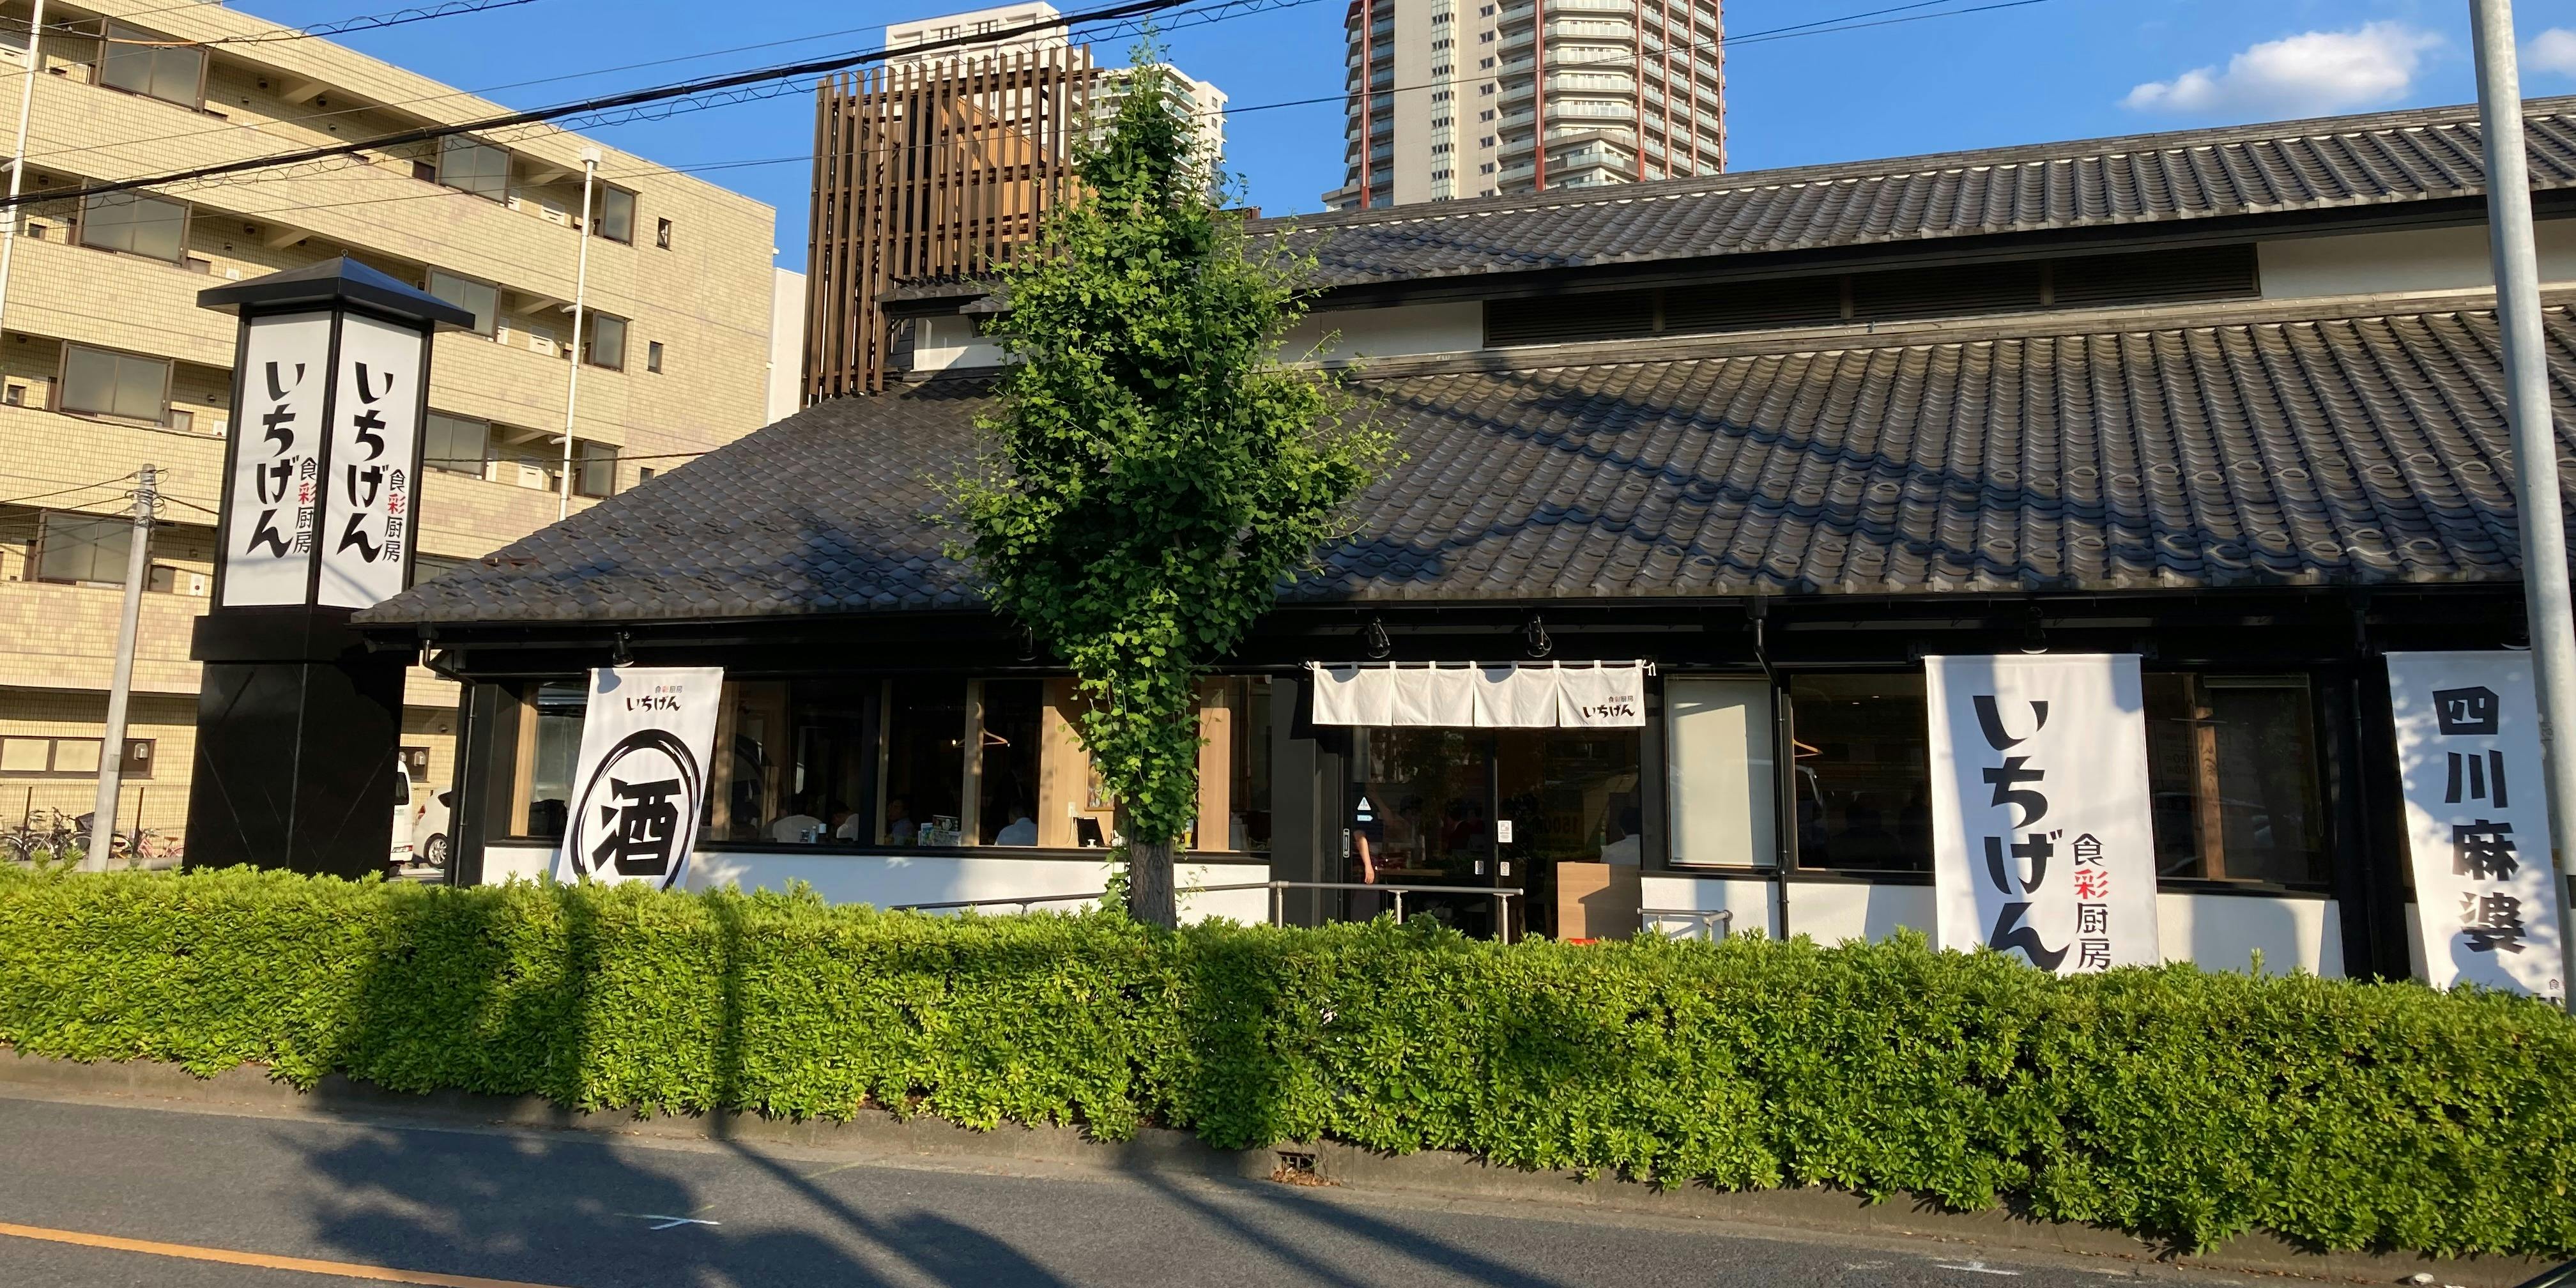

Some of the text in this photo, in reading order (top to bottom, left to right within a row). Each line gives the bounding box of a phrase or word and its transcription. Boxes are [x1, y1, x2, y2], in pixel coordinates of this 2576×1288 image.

[247, 362, 305, 558] いちげん
[293, 457, 317, 555] 食彩厨房
[337, 362, 393, 563] いちげん
[382, 469, 407, 564] 食彩厨房
[627, 696, 681, 712] いちげん
[1583, 705, 1635, 718] いちげん
[592, 777, 682, 875] 酒
[1973, 696, 2071, 970] いちげん
[2432, 686, 2526, 954] 四川麻婆
[2072, 833, 2112, 969] 食彩厨房
